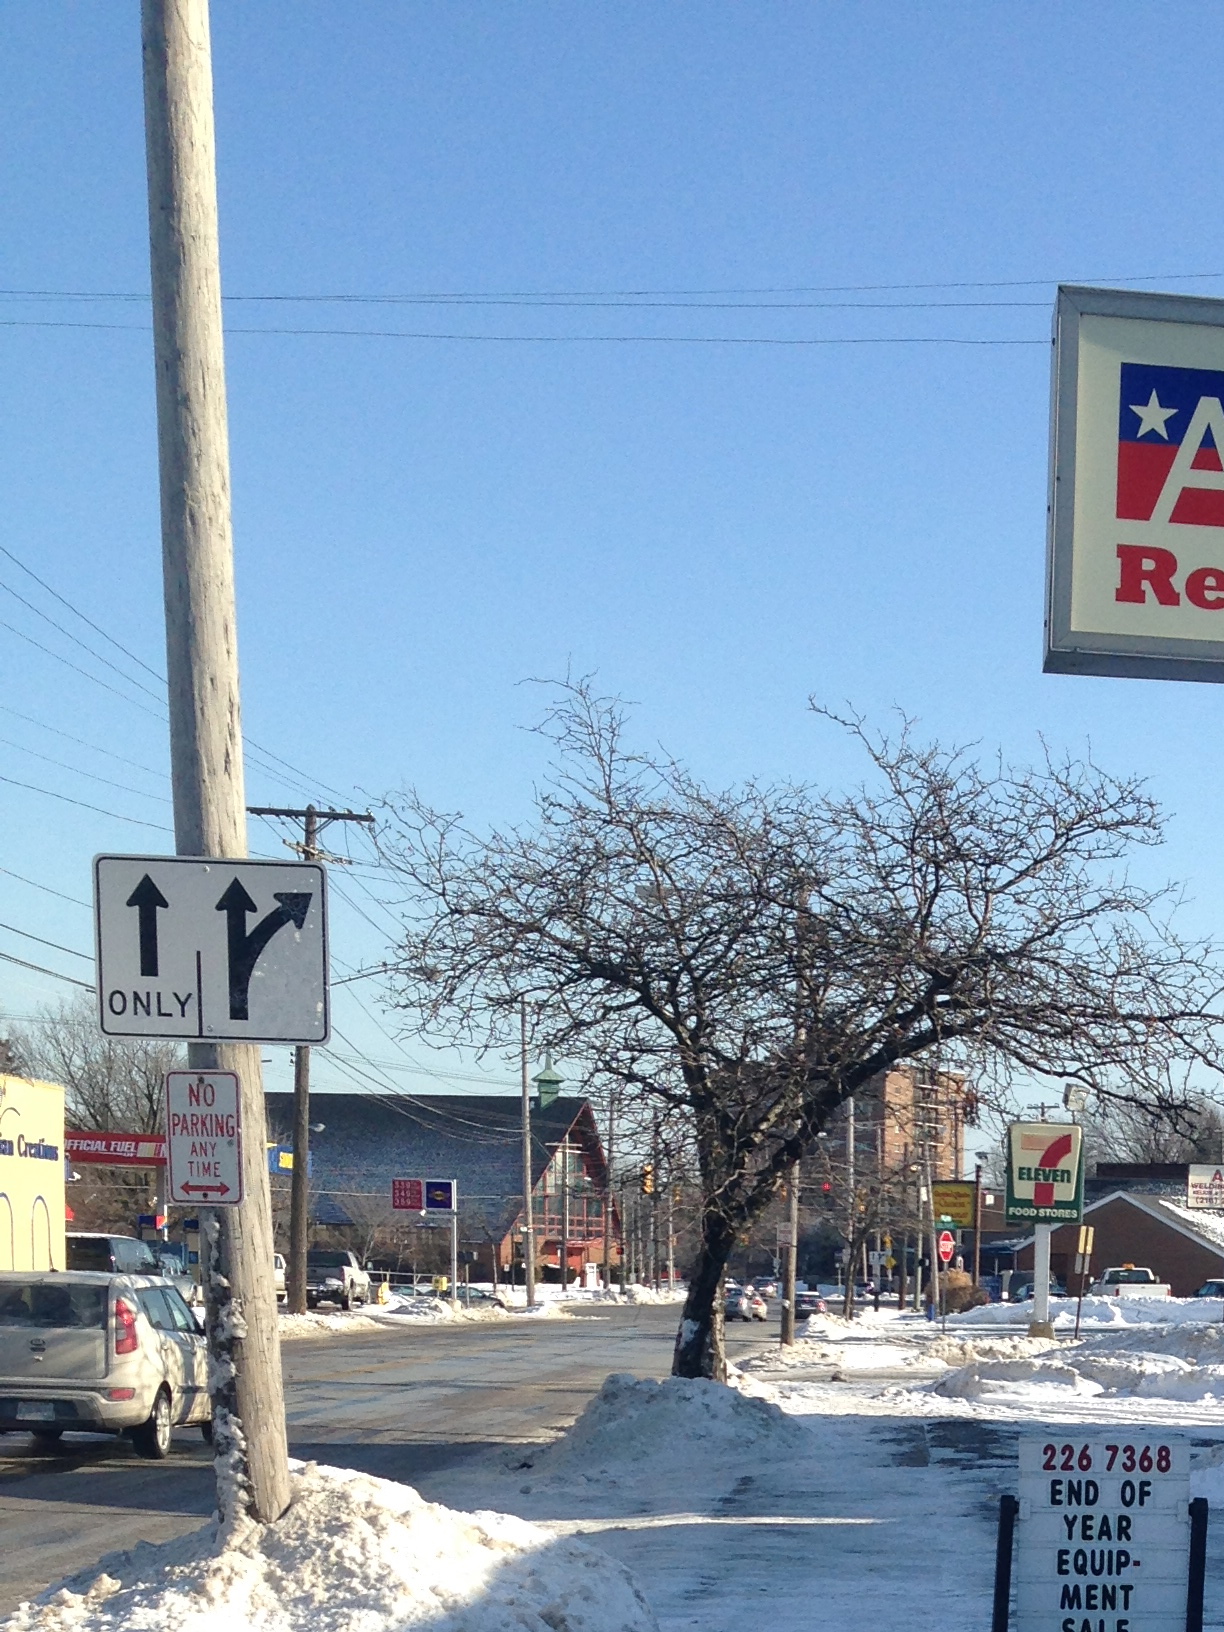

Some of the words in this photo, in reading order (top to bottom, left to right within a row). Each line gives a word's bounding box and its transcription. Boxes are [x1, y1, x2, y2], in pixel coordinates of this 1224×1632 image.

[108, 989, 193, 1018] ONLY
[188, 1083, 216, 1107] NO
[171, 1112, 236, 1138] PARKING
[110, 1141, 137, 1153] FUEL
[190, 1142, 217, 1158] ANY
[187, 1161, 221, 1178] TIME
[1020, 1132, 1073, 1206] 7
[1008, 1206, 1037, 1216] FOOD
[1038, 1208, 1078, 1219] STORES
[1042, 1443, 1093, 1472] 226
[1105, 1444, 1172, 1473] 7368
[1050, 1479, 1099, 1507] END
[1120, 1479, 1153, 1508] OF
[1063, 1513, 1132, 1542] YEAR
[1056, 1548, 1141, 1577] EQUIP-
[1059, 1583, 1134, 1611] MENT
